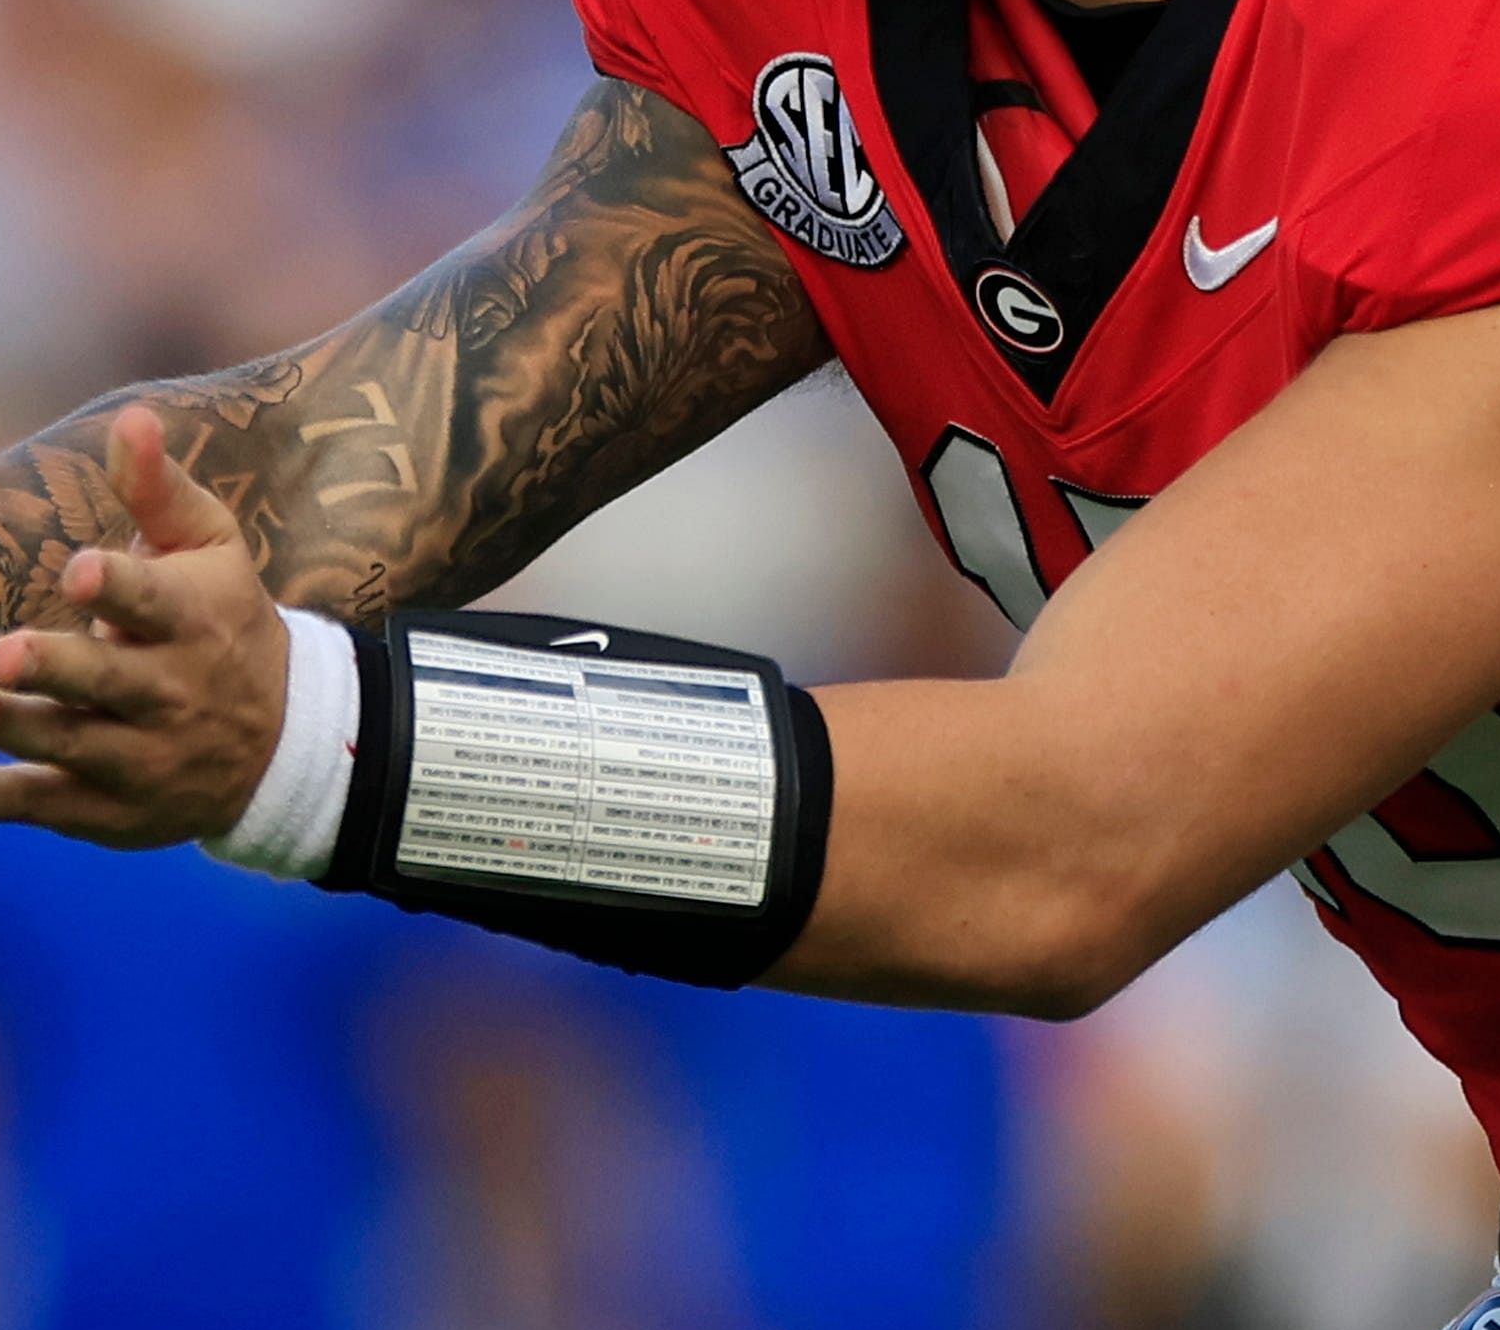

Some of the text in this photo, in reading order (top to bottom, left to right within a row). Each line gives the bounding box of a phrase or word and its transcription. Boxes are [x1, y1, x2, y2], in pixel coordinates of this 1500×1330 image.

[764, 67, 875, 216] SEC
[752, 176, 892, 265] GRADUATE
[976, 270, 1063, 352] G
